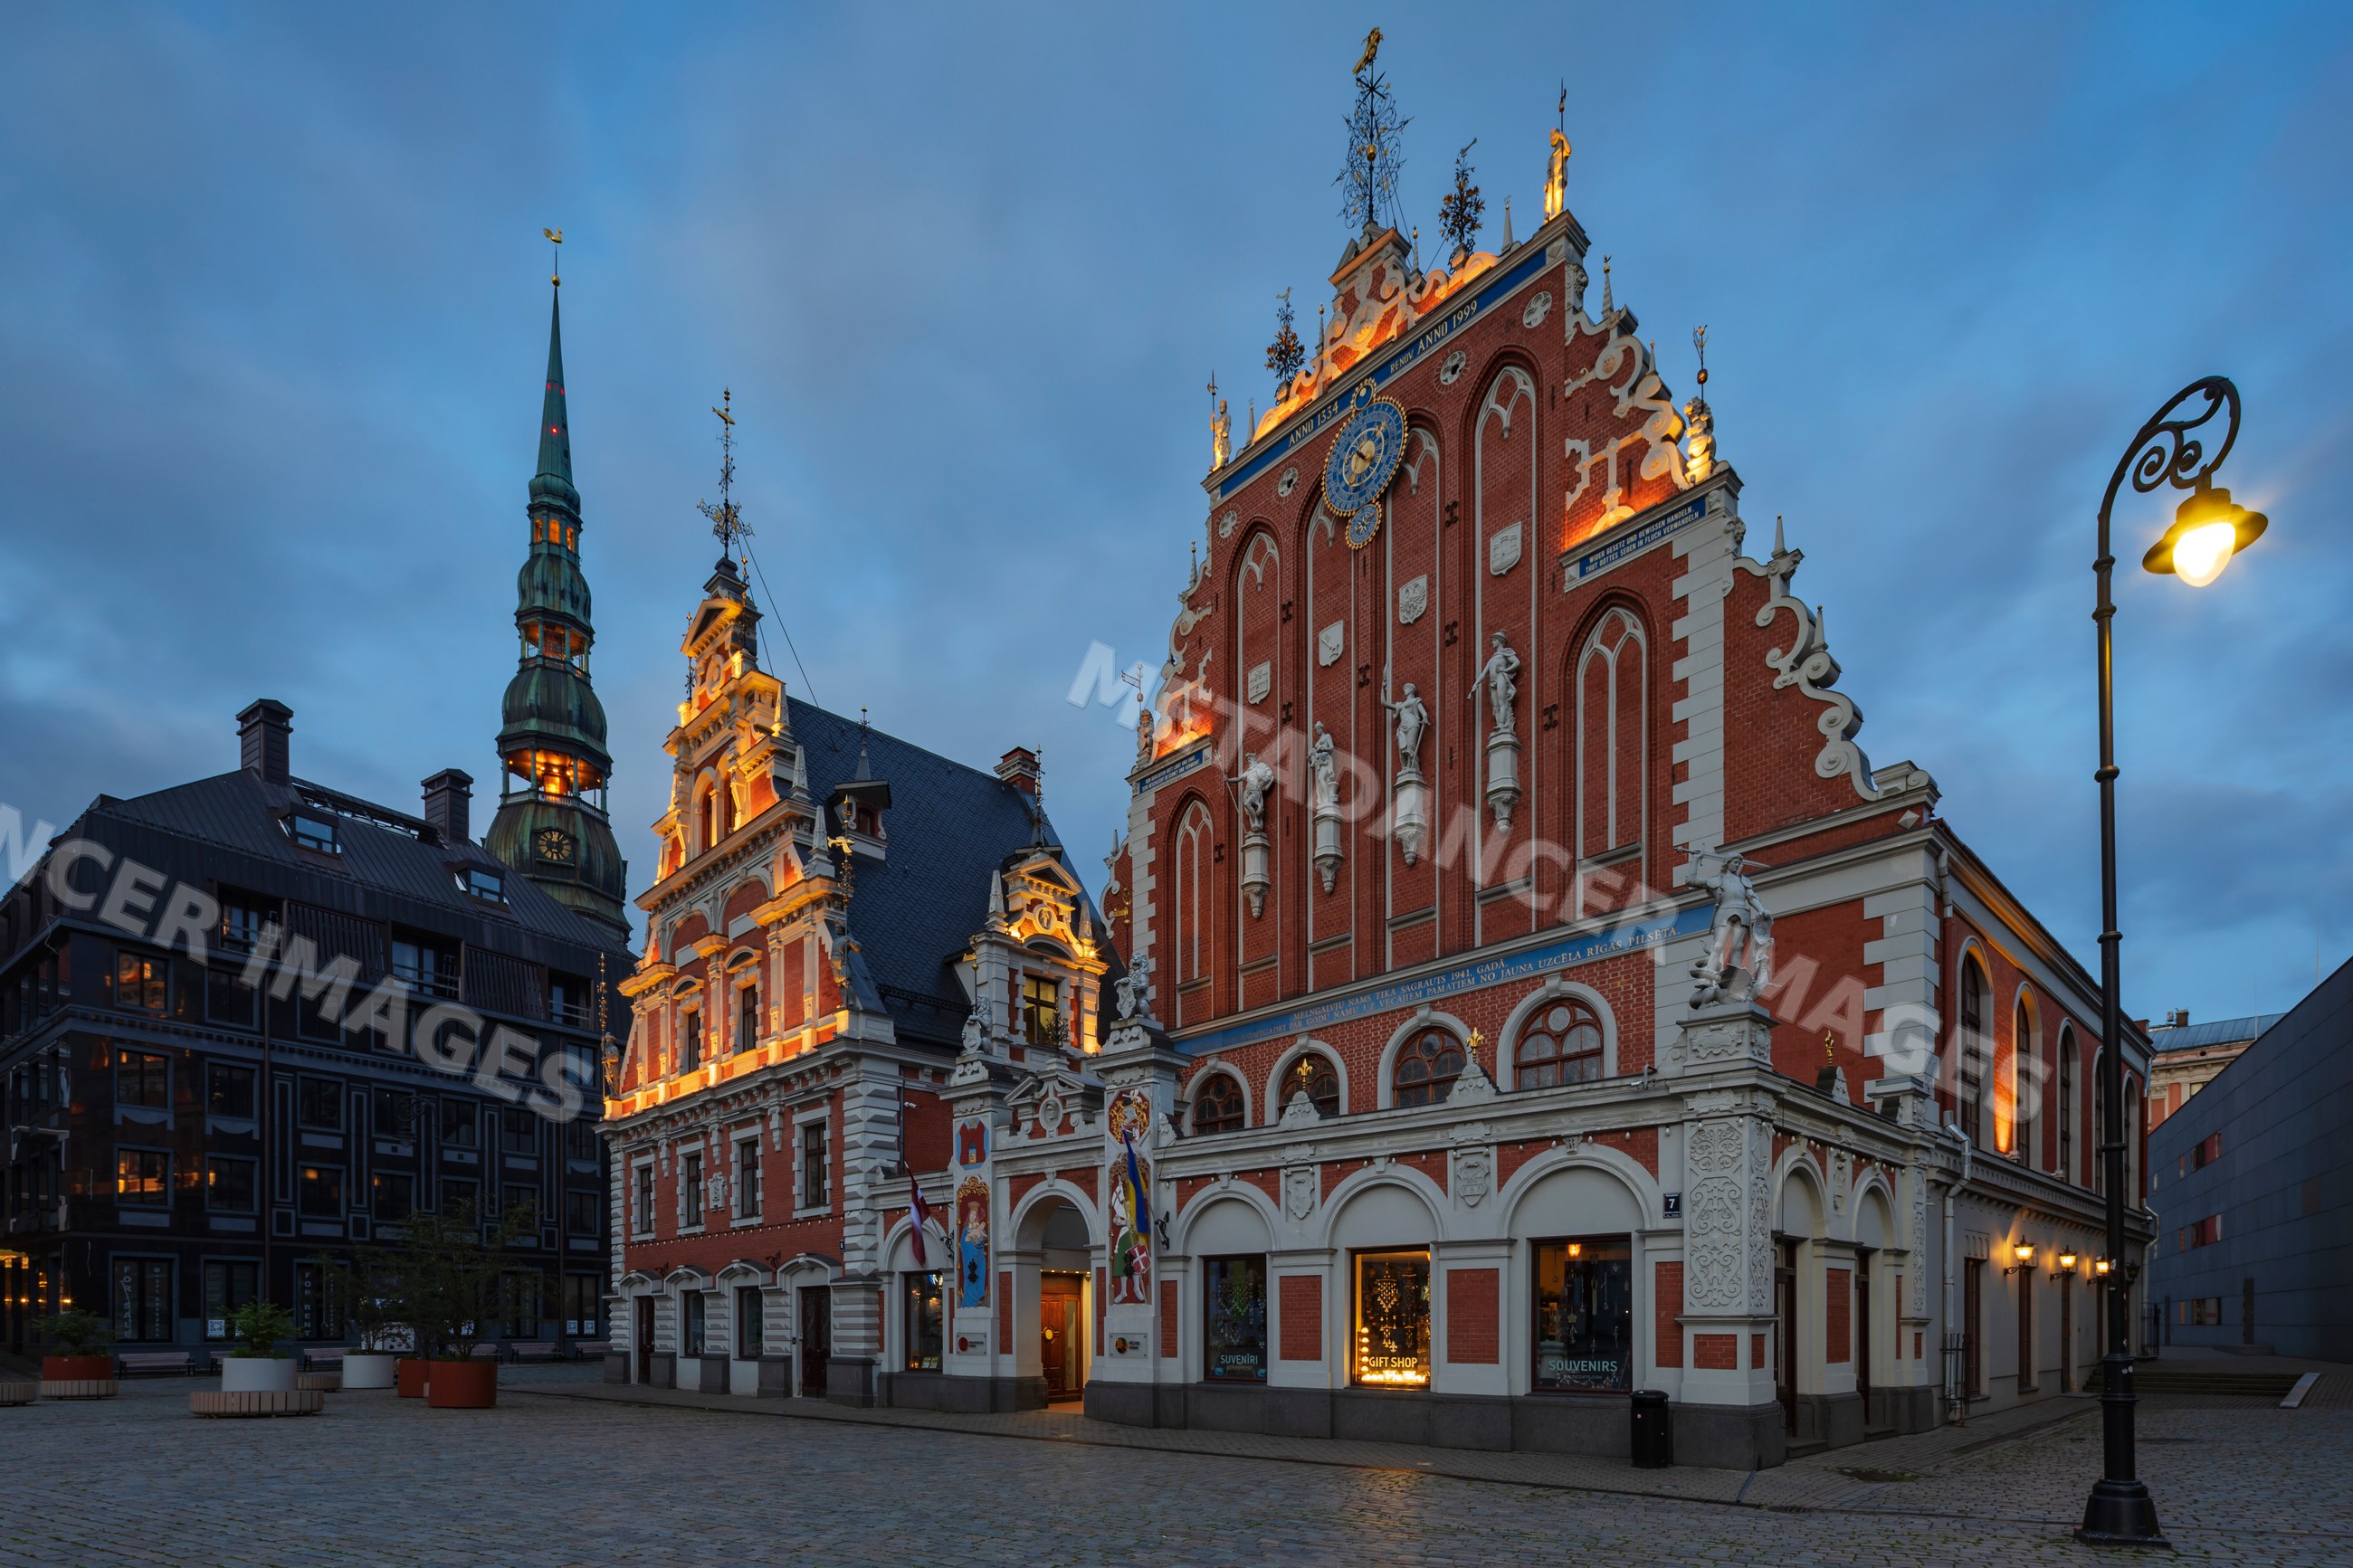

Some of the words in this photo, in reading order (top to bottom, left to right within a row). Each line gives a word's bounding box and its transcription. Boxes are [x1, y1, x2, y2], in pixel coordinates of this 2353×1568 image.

[1417, 321, 1448, 356] ANNO
[1453, 299, 1478, 330] 1999
[1288, 419, 1314, 448] ANNO
[1317, 400, 1338, 427] 1334
[1586, 561, 1598, 575] THUT
[1599, 552, 1619, 568] GOTTES
[1620, 543, 1636, 557] SEGEN
[1637, 539, 1643, 548] IN
[1644, 531, 1662, 546] FLUCH
[1662, 511, 1700, 536] VERWANDELN
[1589, 549, 1605, 564] WIDER
[1606, 539, 1625, 556] GESETZ
[1626, 535, 1638, 546] UND
[1638, 520, 1666, 540] GEWISSEN
[1289, 1020, 1302, 1030] PAR
[1306, 1013, 1330, 1025] GODU
[1426, 978, 1476, 996] PAMATIEM
[1480, 972, 1496, 984] NO
[1500, 962, 1534, 979] JAUNA
[1538, 950, 1582, 969] UZCĒLA
[1586, 940, 1622, 957] RĪGAS
[1628, 927, 1681, 947] PILSĒTA.
[1348, 993, 1371, 1007] NAMS
[1376, 988, 1396, 1000] TIKA
[1400, 974, 1446, 993] SAGRAUTS
[1451, 968, 1472, 981] 1941.
[1476, 959, 1509, 974] GADĀ.
[1668, 1198, 1676, 1209] 7
[123, 1266, 132, 1293] FOR
[303, 1272, 312, 1296] FOR
[122, 1302, 132, 1338] SALE
[303, 1304, 312, 1337] RENT
[1220, 1353, 1259, 1364] SUVENĪRI
[1368, 1356, 1389, 1367] GIFT
[1390, 1356, 1418, 1368] SHOP
[1548, 1359, 1618, 1373] SOUVENIRS
